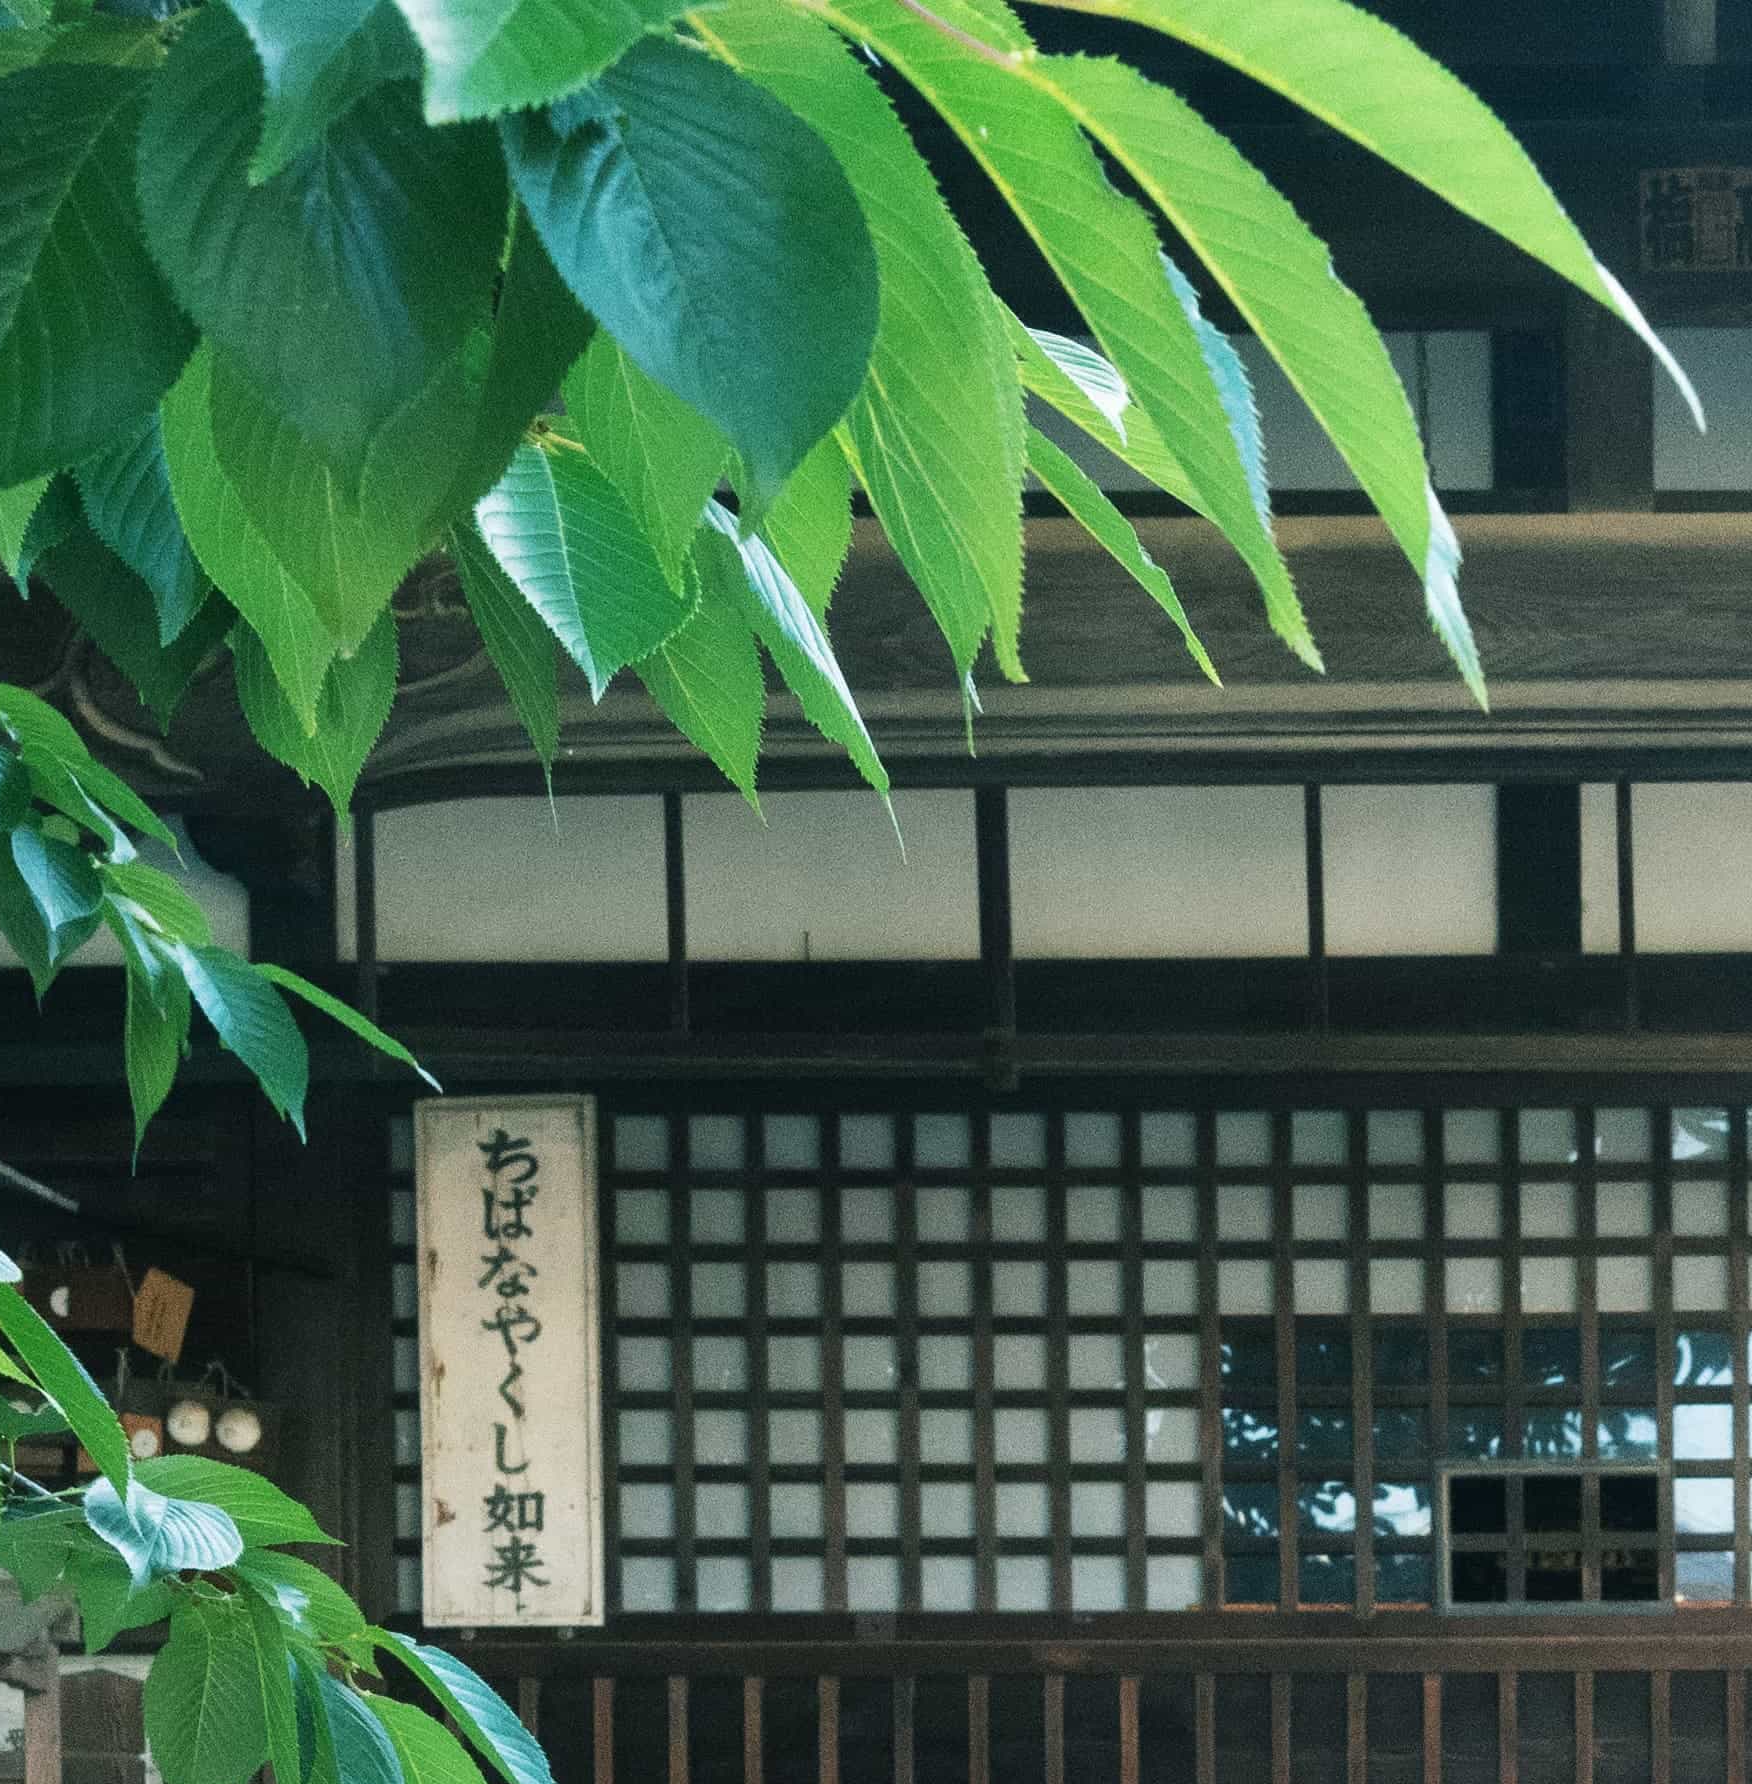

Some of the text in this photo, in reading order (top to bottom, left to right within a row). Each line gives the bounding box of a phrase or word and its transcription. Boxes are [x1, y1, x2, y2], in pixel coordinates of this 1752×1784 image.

[476, 1127, 551, 1594] ちばなやくし如来
